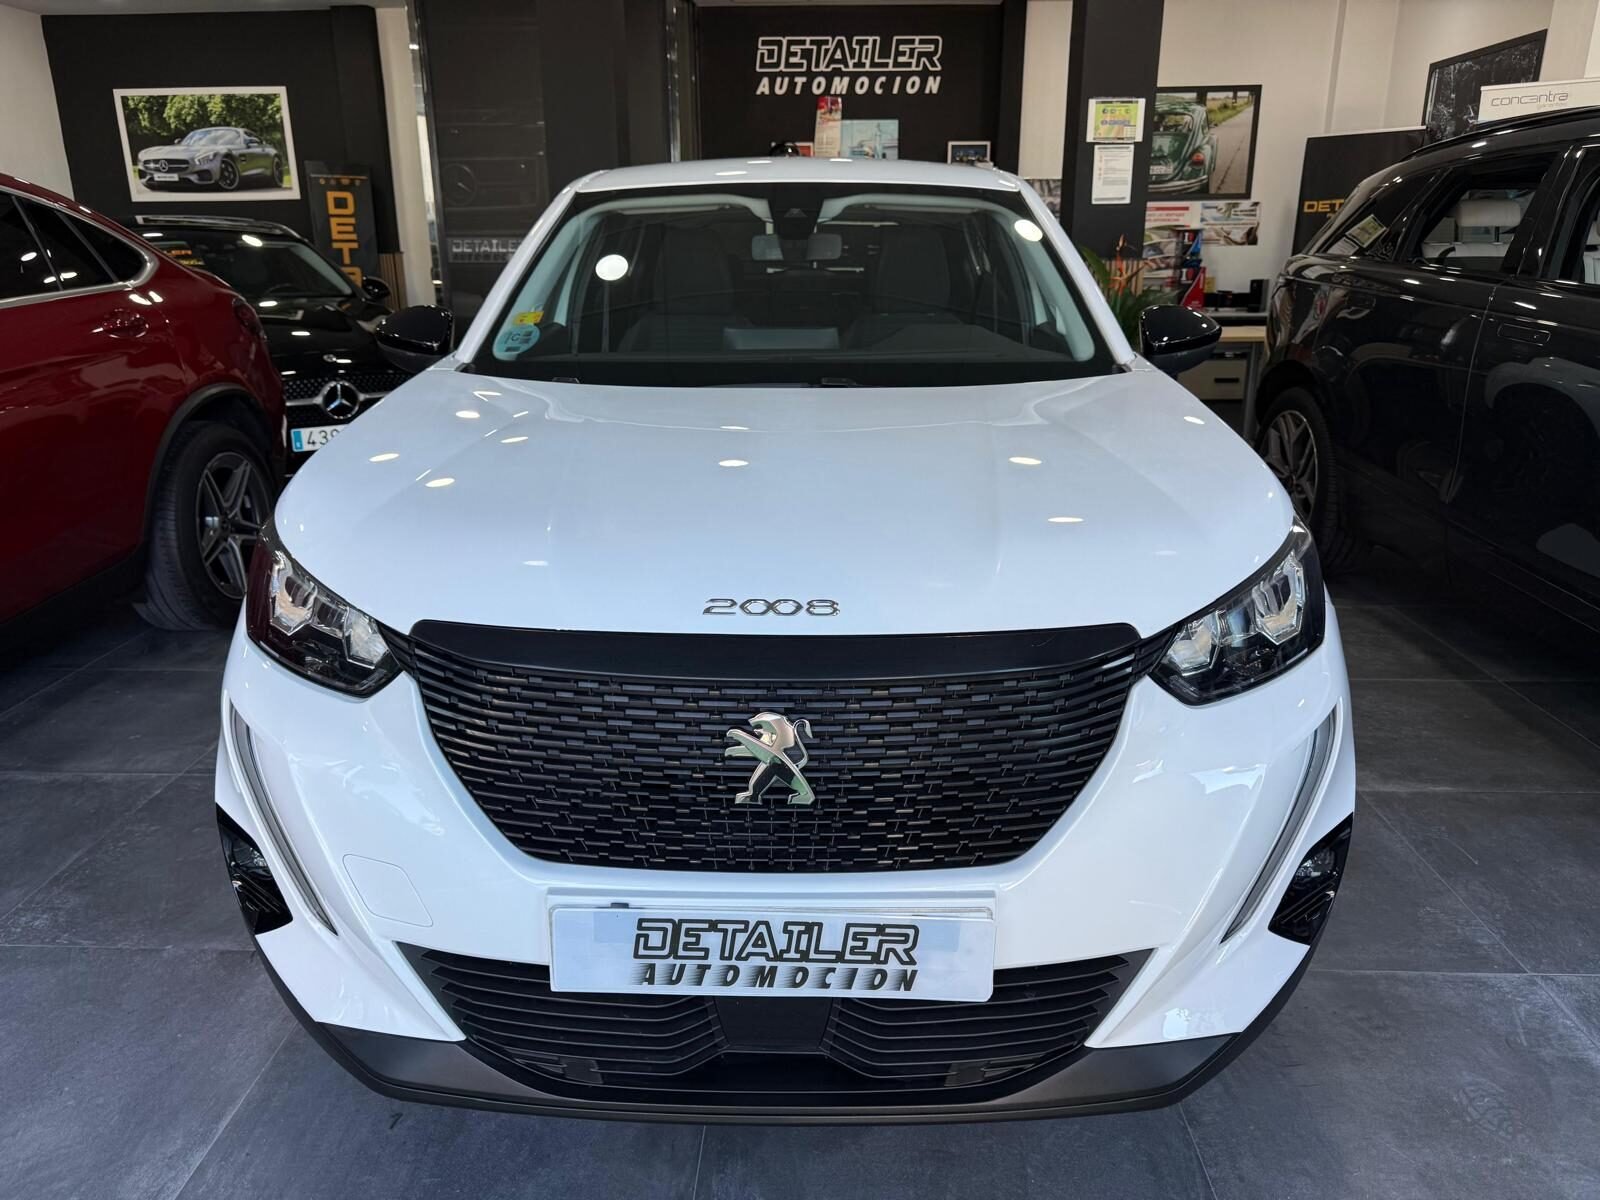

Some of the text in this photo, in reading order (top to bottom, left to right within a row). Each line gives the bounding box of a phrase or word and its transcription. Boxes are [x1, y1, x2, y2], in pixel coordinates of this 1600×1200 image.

[756, 36, 943, 72] DETAILER
[756, 76, 941, 95] AUTOMOCION
[702, 597, 841, 617] 2008
[633, 917, 920, 966] DETAILER
[634, 964, 919, 992] AUTOMOCION
